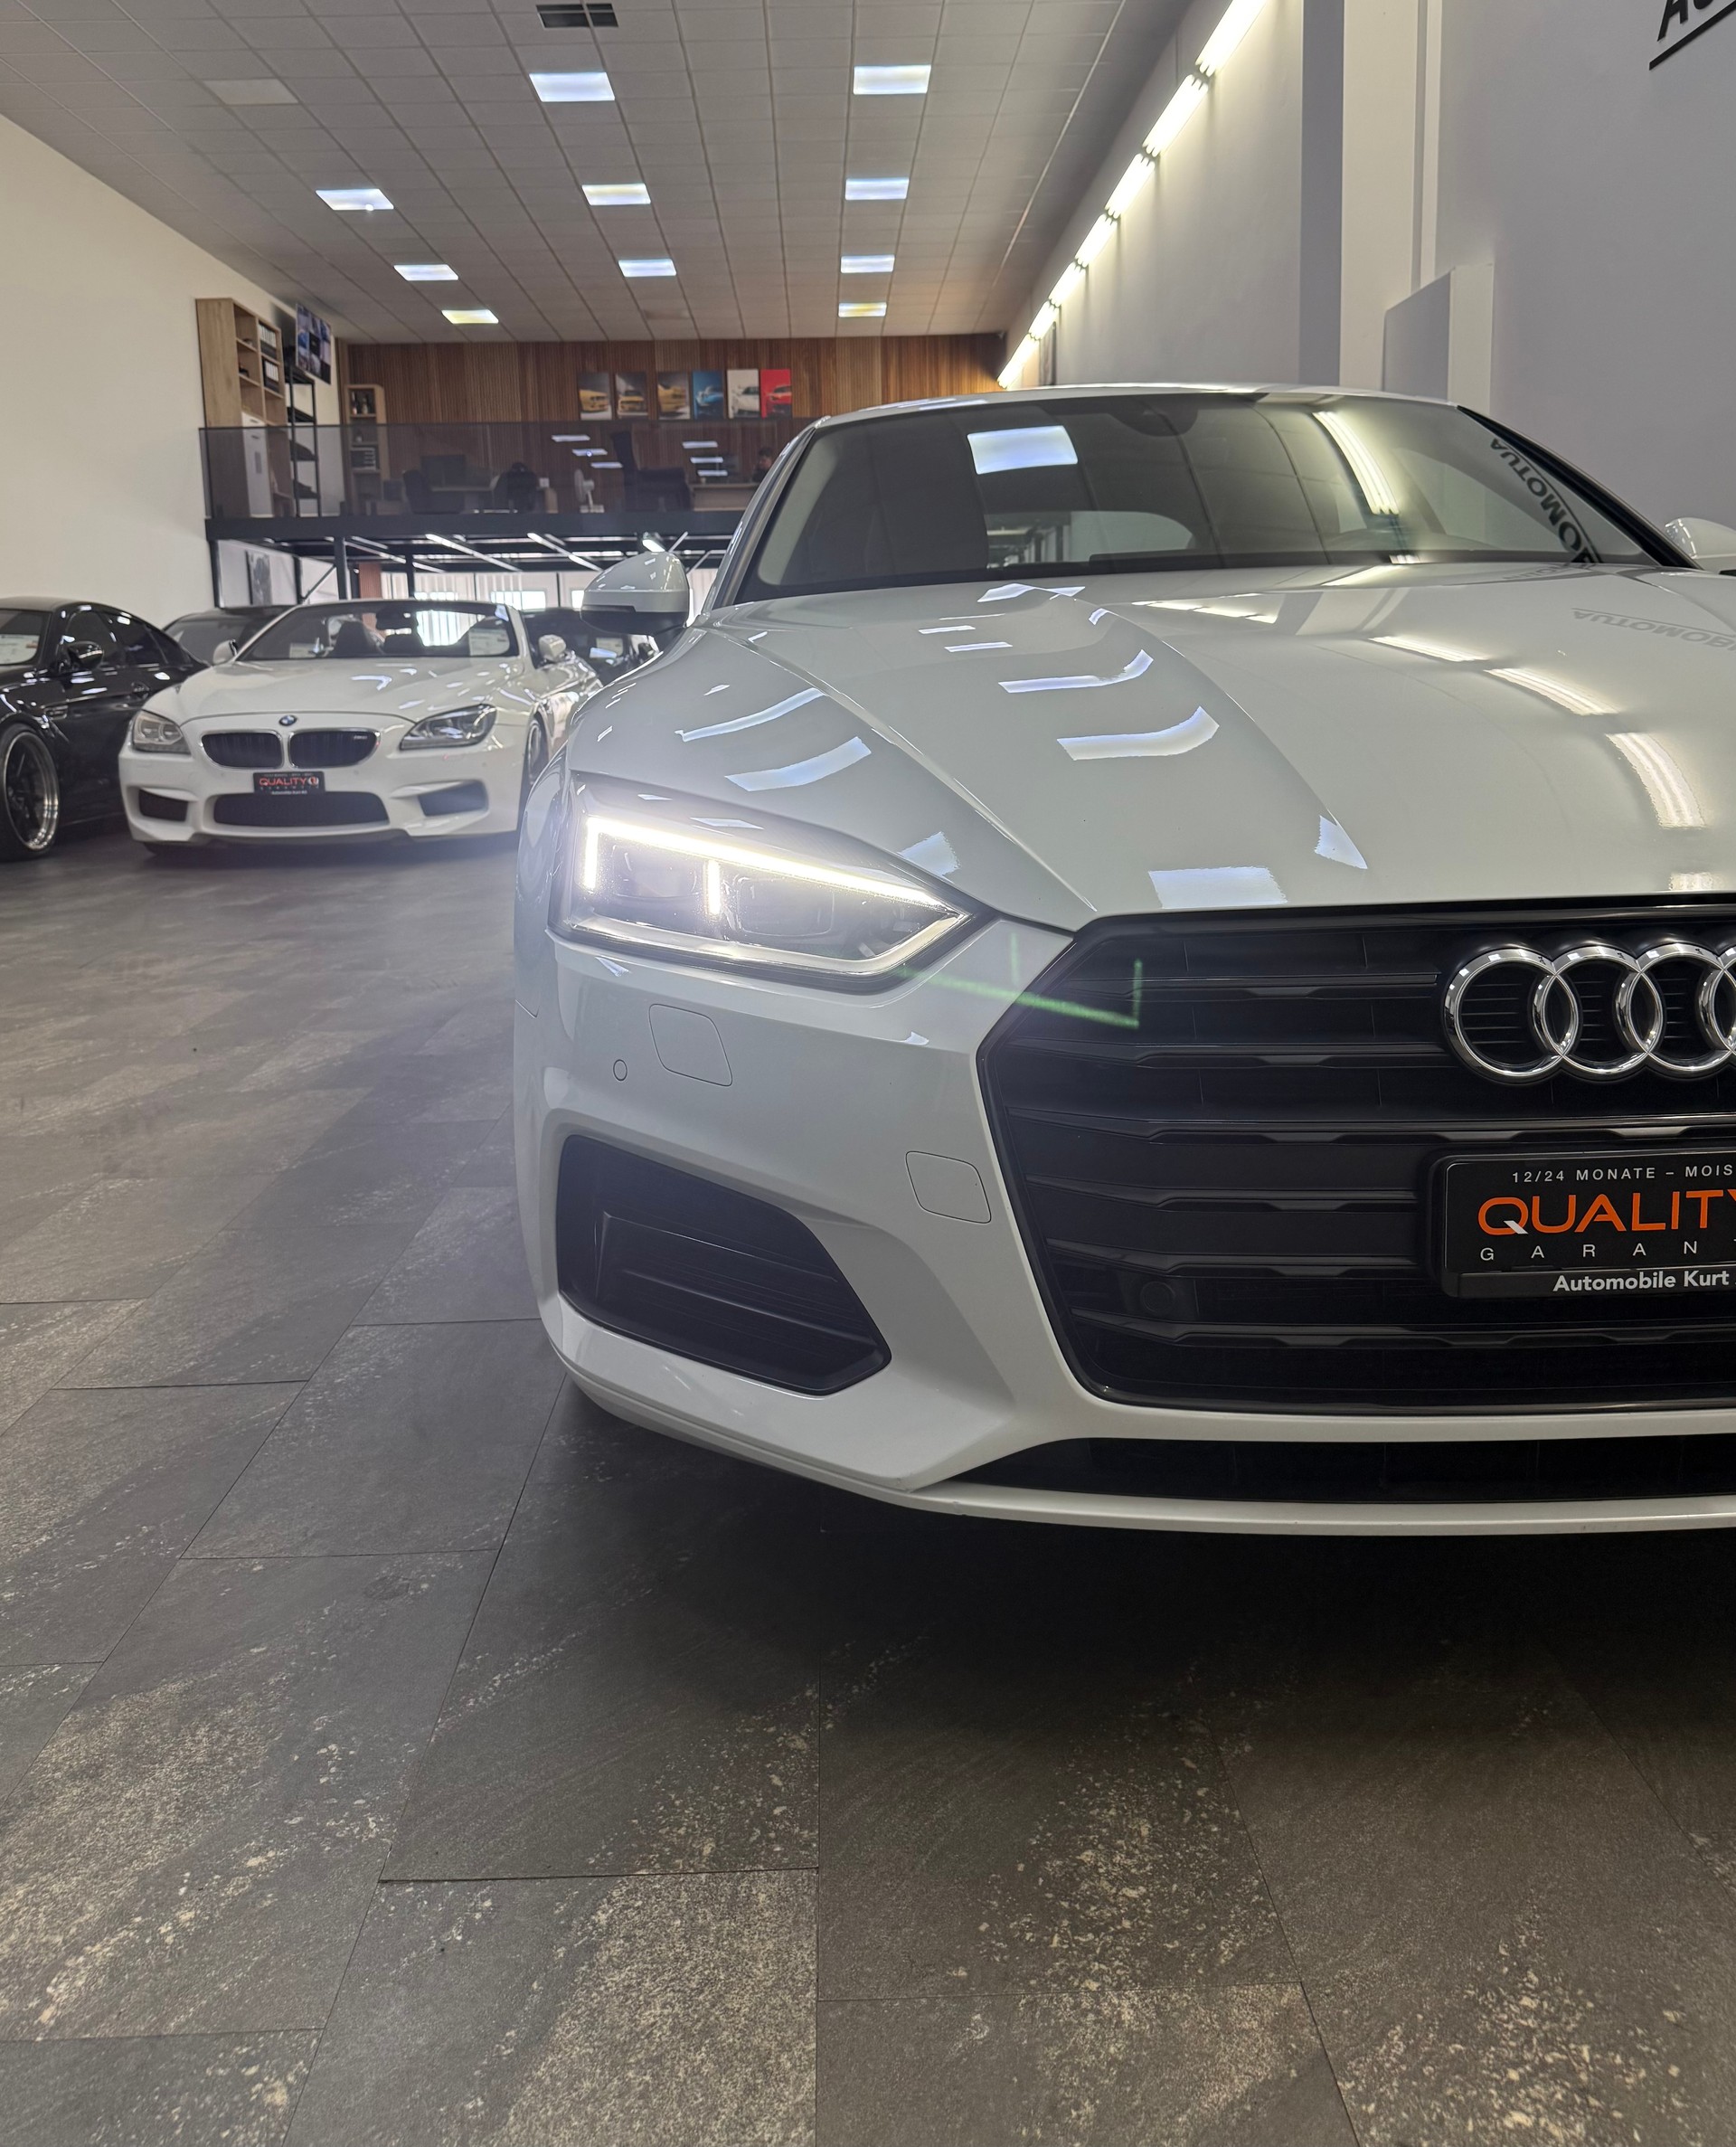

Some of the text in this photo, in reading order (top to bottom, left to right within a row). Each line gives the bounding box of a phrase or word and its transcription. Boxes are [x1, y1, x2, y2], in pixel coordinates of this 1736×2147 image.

[1513, 1170, 1565, 1183] 12/24
[1576, 1168, 1656, 1181] MONATE
[1685, 1164, 1733, 1178] MOIS
[1480, 1238, 1736, 1262] GARAN
[1552, 1270, 1730, 1292] Automobile Kurt
